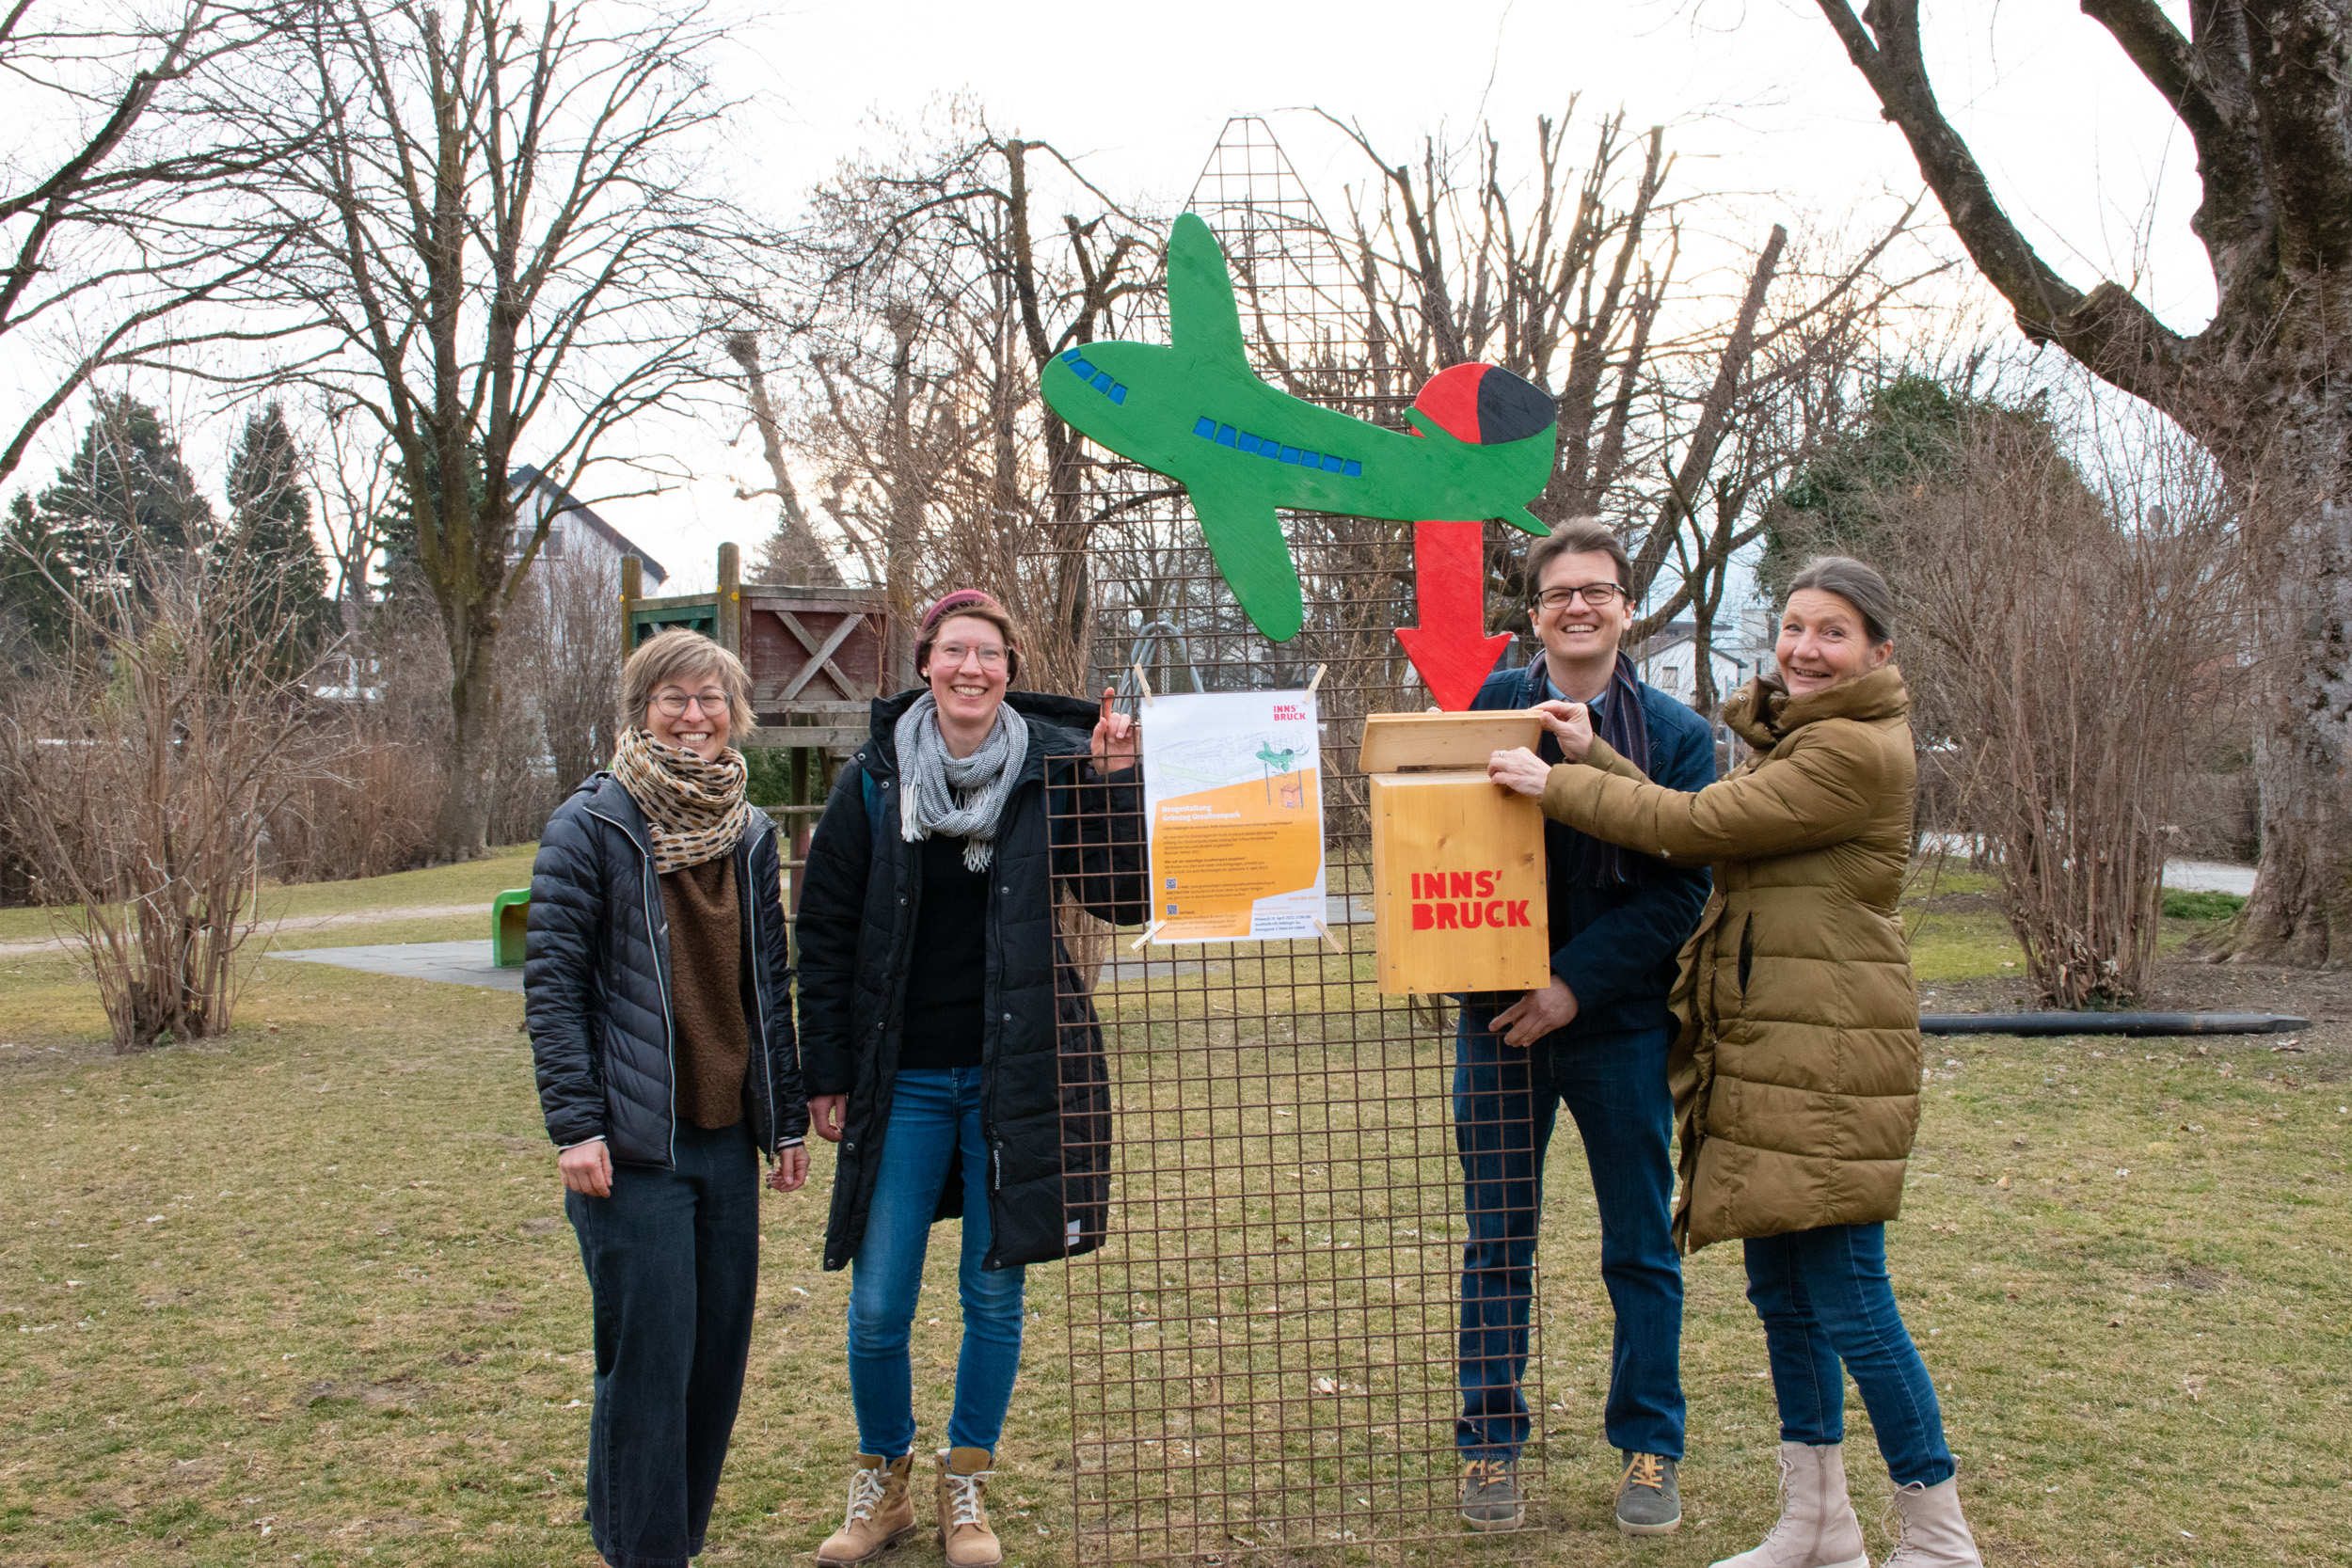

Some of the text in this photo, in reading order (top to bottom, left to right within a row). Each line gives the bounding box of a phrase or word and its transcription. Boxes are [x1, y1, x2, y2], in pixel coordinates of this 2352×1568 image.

[1273, 705, 1298, 713] INNS'
[1162, 804, 1212, 814] Neugestaltung
[1411, 870, 1502, 899] INNS'
[1412, 900, 1532, 930] BRUCK
